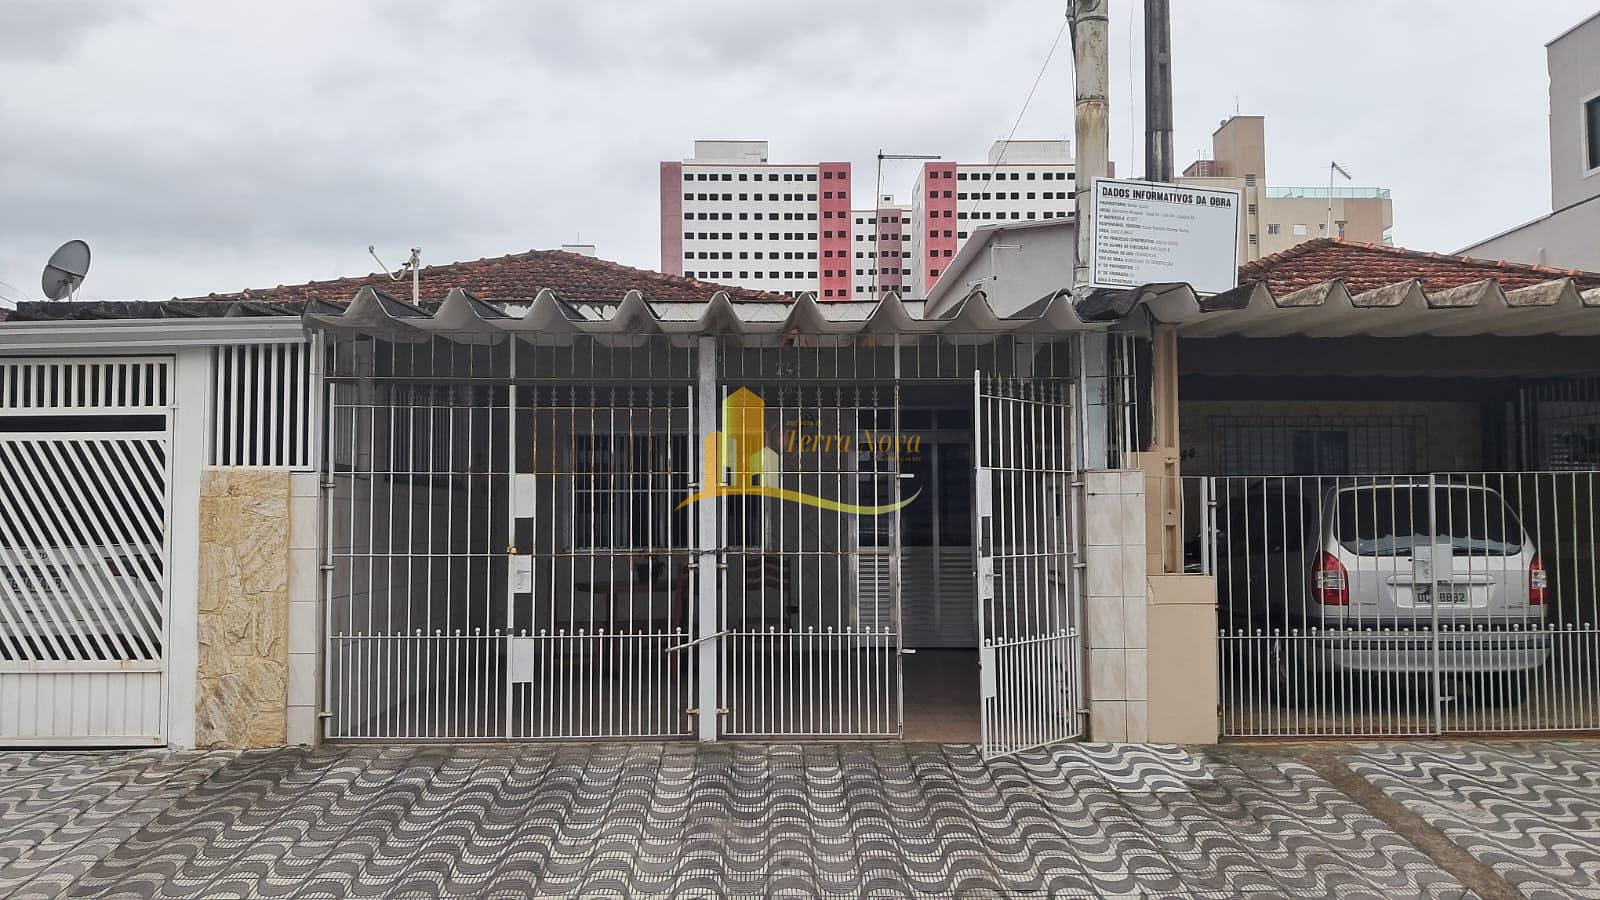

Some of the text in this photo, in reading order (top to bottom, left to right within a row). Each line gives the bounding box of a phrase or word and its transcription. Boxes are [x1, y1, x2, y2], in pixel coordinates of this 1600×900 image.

[1102, 187, 1231, 207] DADOS INFORMATIVOS DA OBRA
